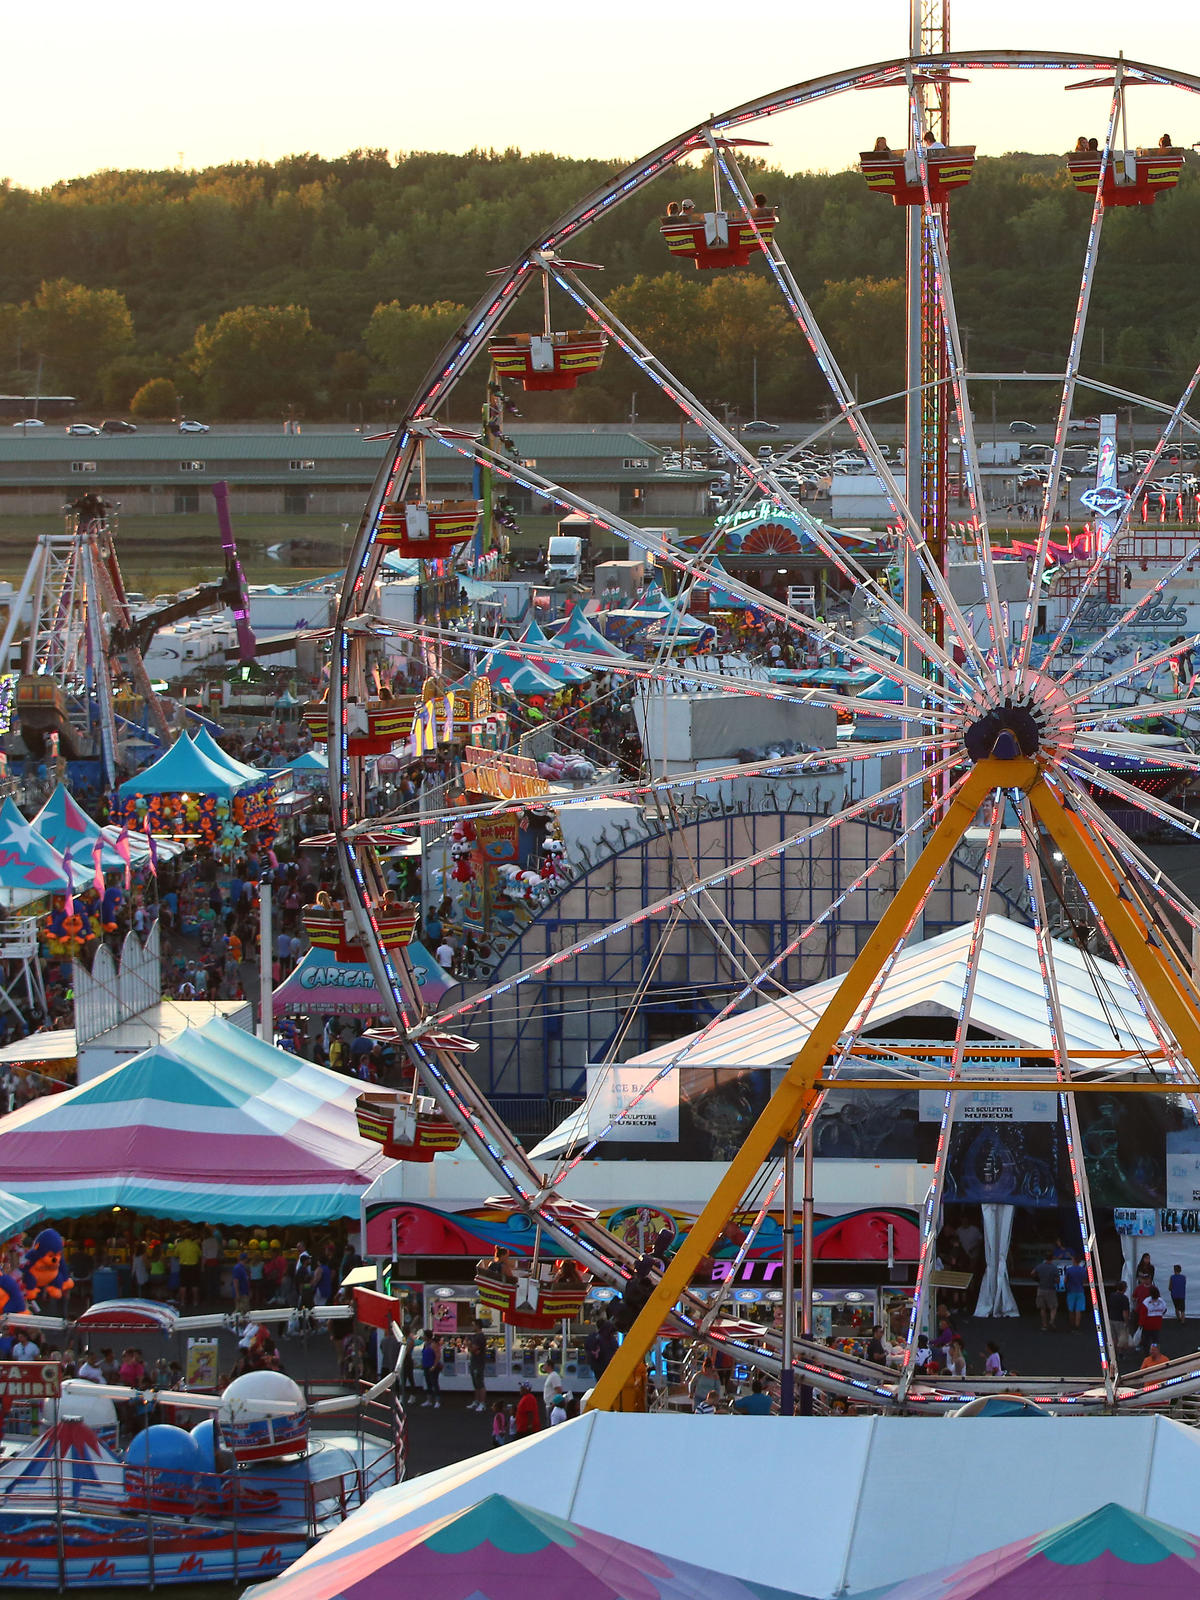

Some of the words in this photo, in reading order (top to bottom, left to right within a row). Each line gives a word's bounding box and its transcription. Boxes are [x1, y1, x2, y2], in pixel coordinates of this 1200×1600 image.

[964, 1106, 975, 1114] ICE
[975, 1106, 1014, 1114] SCULPTURE
[1161, 1209, 1178, 1232] ICE
